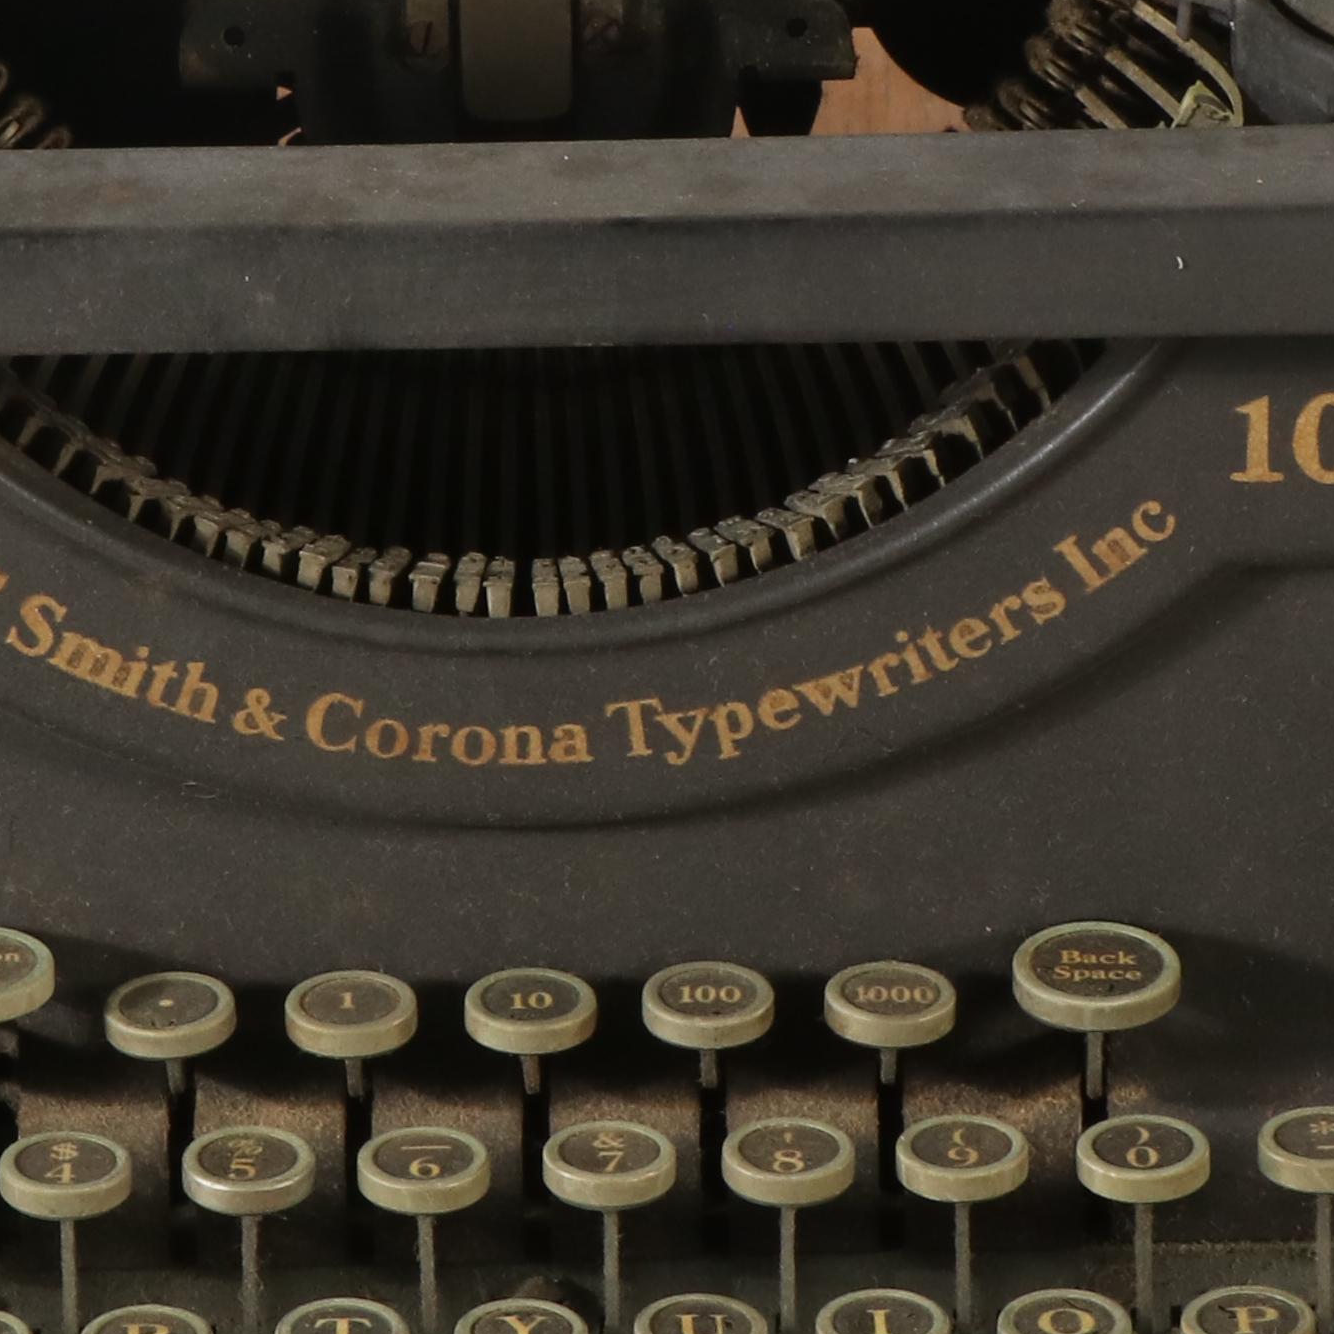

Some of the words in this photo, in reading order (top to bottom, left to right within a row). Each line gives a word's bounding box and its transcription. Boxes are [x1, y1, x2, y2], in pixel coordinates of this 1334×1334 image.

[5, 594, 222, 725] Smith
[234, 688, 286, 741] &
[306, 692, 594, 767] Corona
[605, 563, 1069, 767] Typewriters
[1054, 497, 1177, 595] Inc
[1060, 949, 1138, 965] Back
[1053, 965, 1142, 982] Space
[339, 990, 356, 1010] 1
[510, 991, 553, 1010] 10
[679, 984, 741, 1004] 100
[855, 984, 933, 1005] 1000
[50, 1142, 79, 1160] $
[592, 1132, 625, 1150] &
[597, 1150, 624, 1172] 7
[773, 1149, 805, 1173] 8
[947, 1147, 978, 1167] 9
[44, 1162, 75, 1184] 4
[229, 1160, 257, 1180] 5
[409, 1157, 442, 1179] 6
[1227, 1305, 1280, 1334] P
